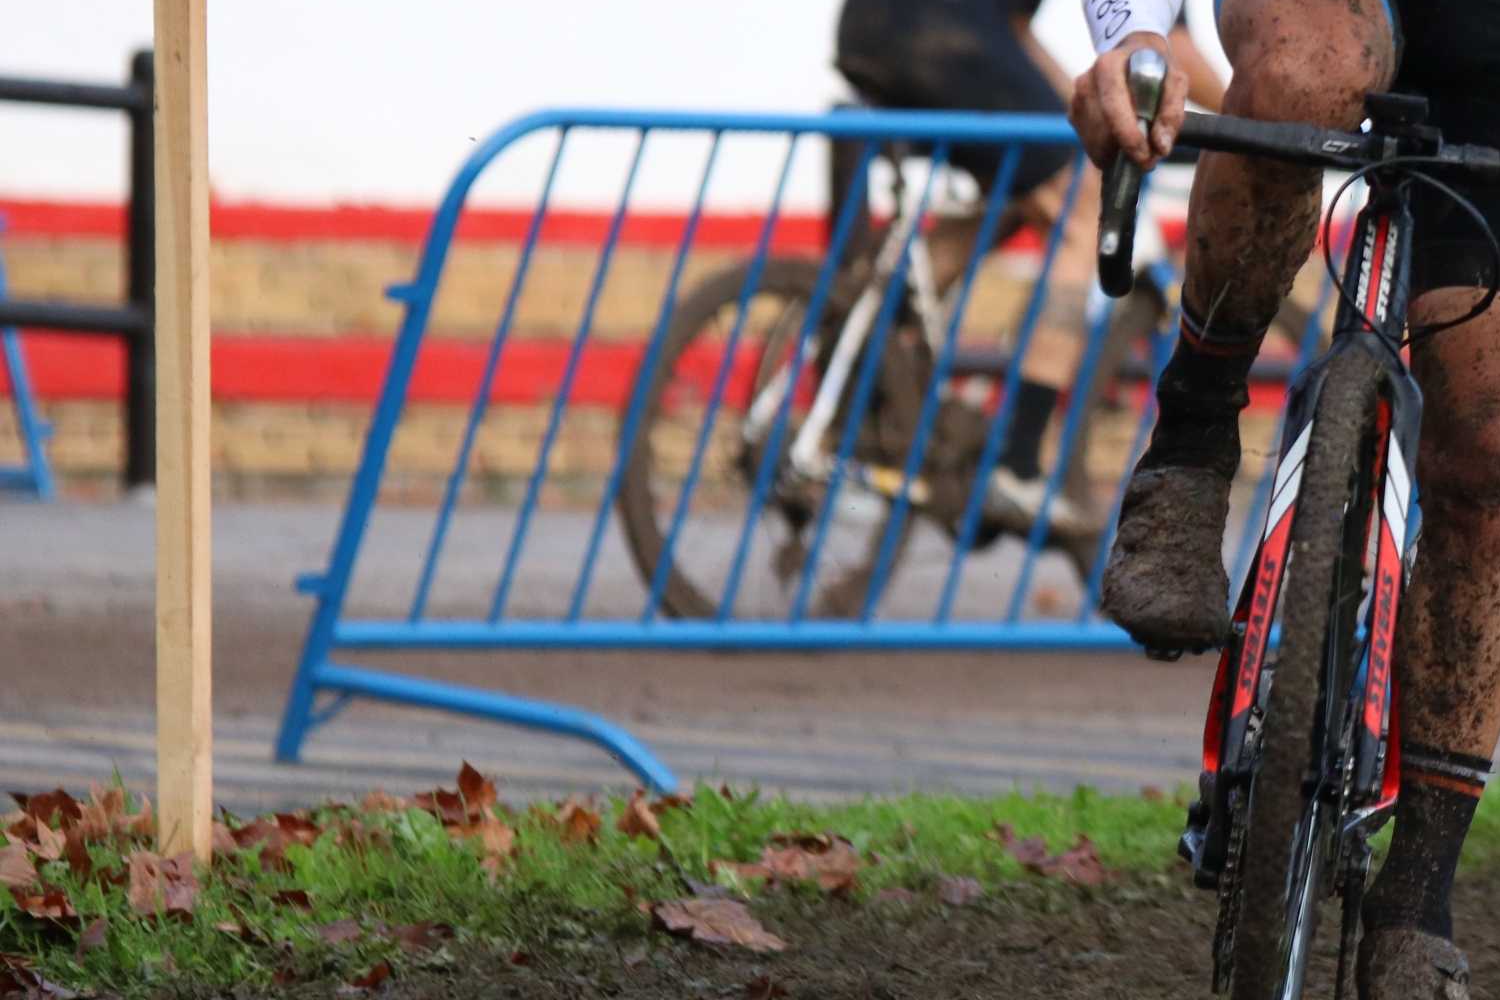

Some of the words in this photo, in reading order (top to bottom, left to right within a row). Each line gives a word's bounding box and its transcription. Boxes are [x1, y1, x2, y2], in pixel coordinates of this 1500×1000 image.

[1355, 218, 1377, 314] STEVENS
[1376, 220, 1399, 324] STEVENS
[1239, 553, 1277, 692] STEVENS
[1370, 568, 1393, 713] STEVENS
